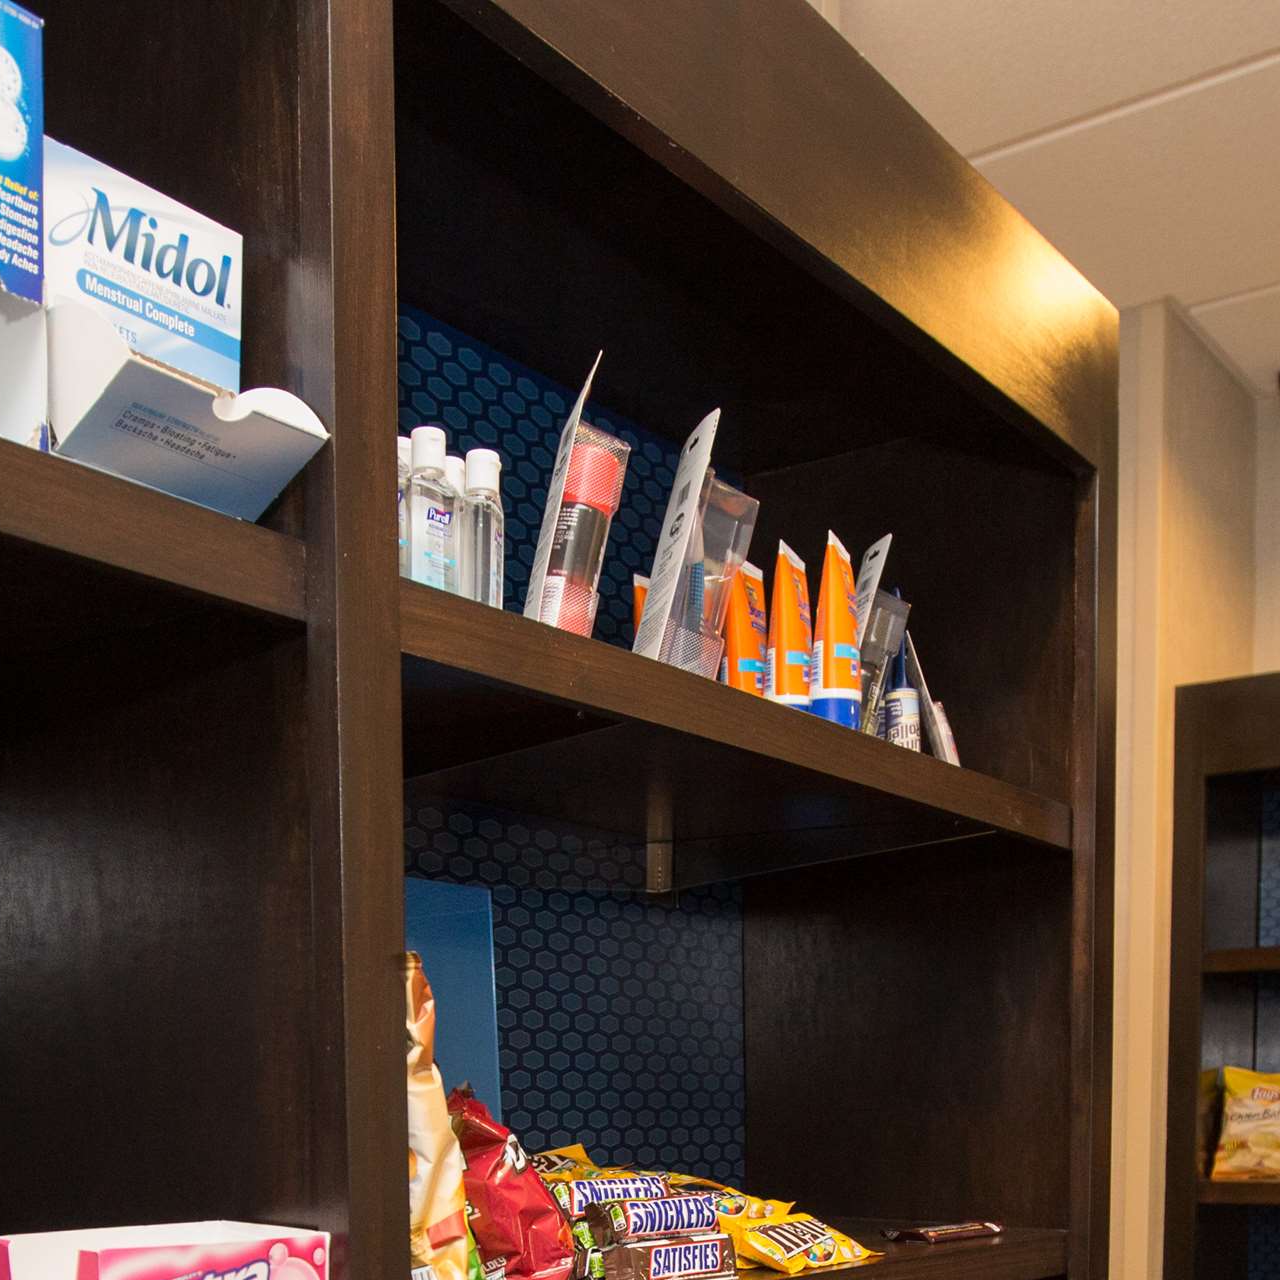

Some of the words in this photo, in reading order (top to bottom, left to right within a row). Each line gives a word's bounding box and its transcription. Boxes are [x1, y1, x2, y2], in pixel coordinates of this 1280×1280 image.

[0, 203, 38, 230] Stomach
[12, 254, 38, 275] Aches
[87, 187, 232, 308] Midol
[85, 273, 144, 313] Menstrual
[145, 302, 196, 337] Complete
[114, 419, 158, 442] Backache
[163, 438, 206, 460] Headache
[122, 410, 155, 429] Cramps
[160, 424, 197, 446] Bloating
[201, 441, 231, 459] Fatigue
[628, 1196, 718, 1236] SNICKERS
[652, 1242, 719, 1278] SATISFIES
